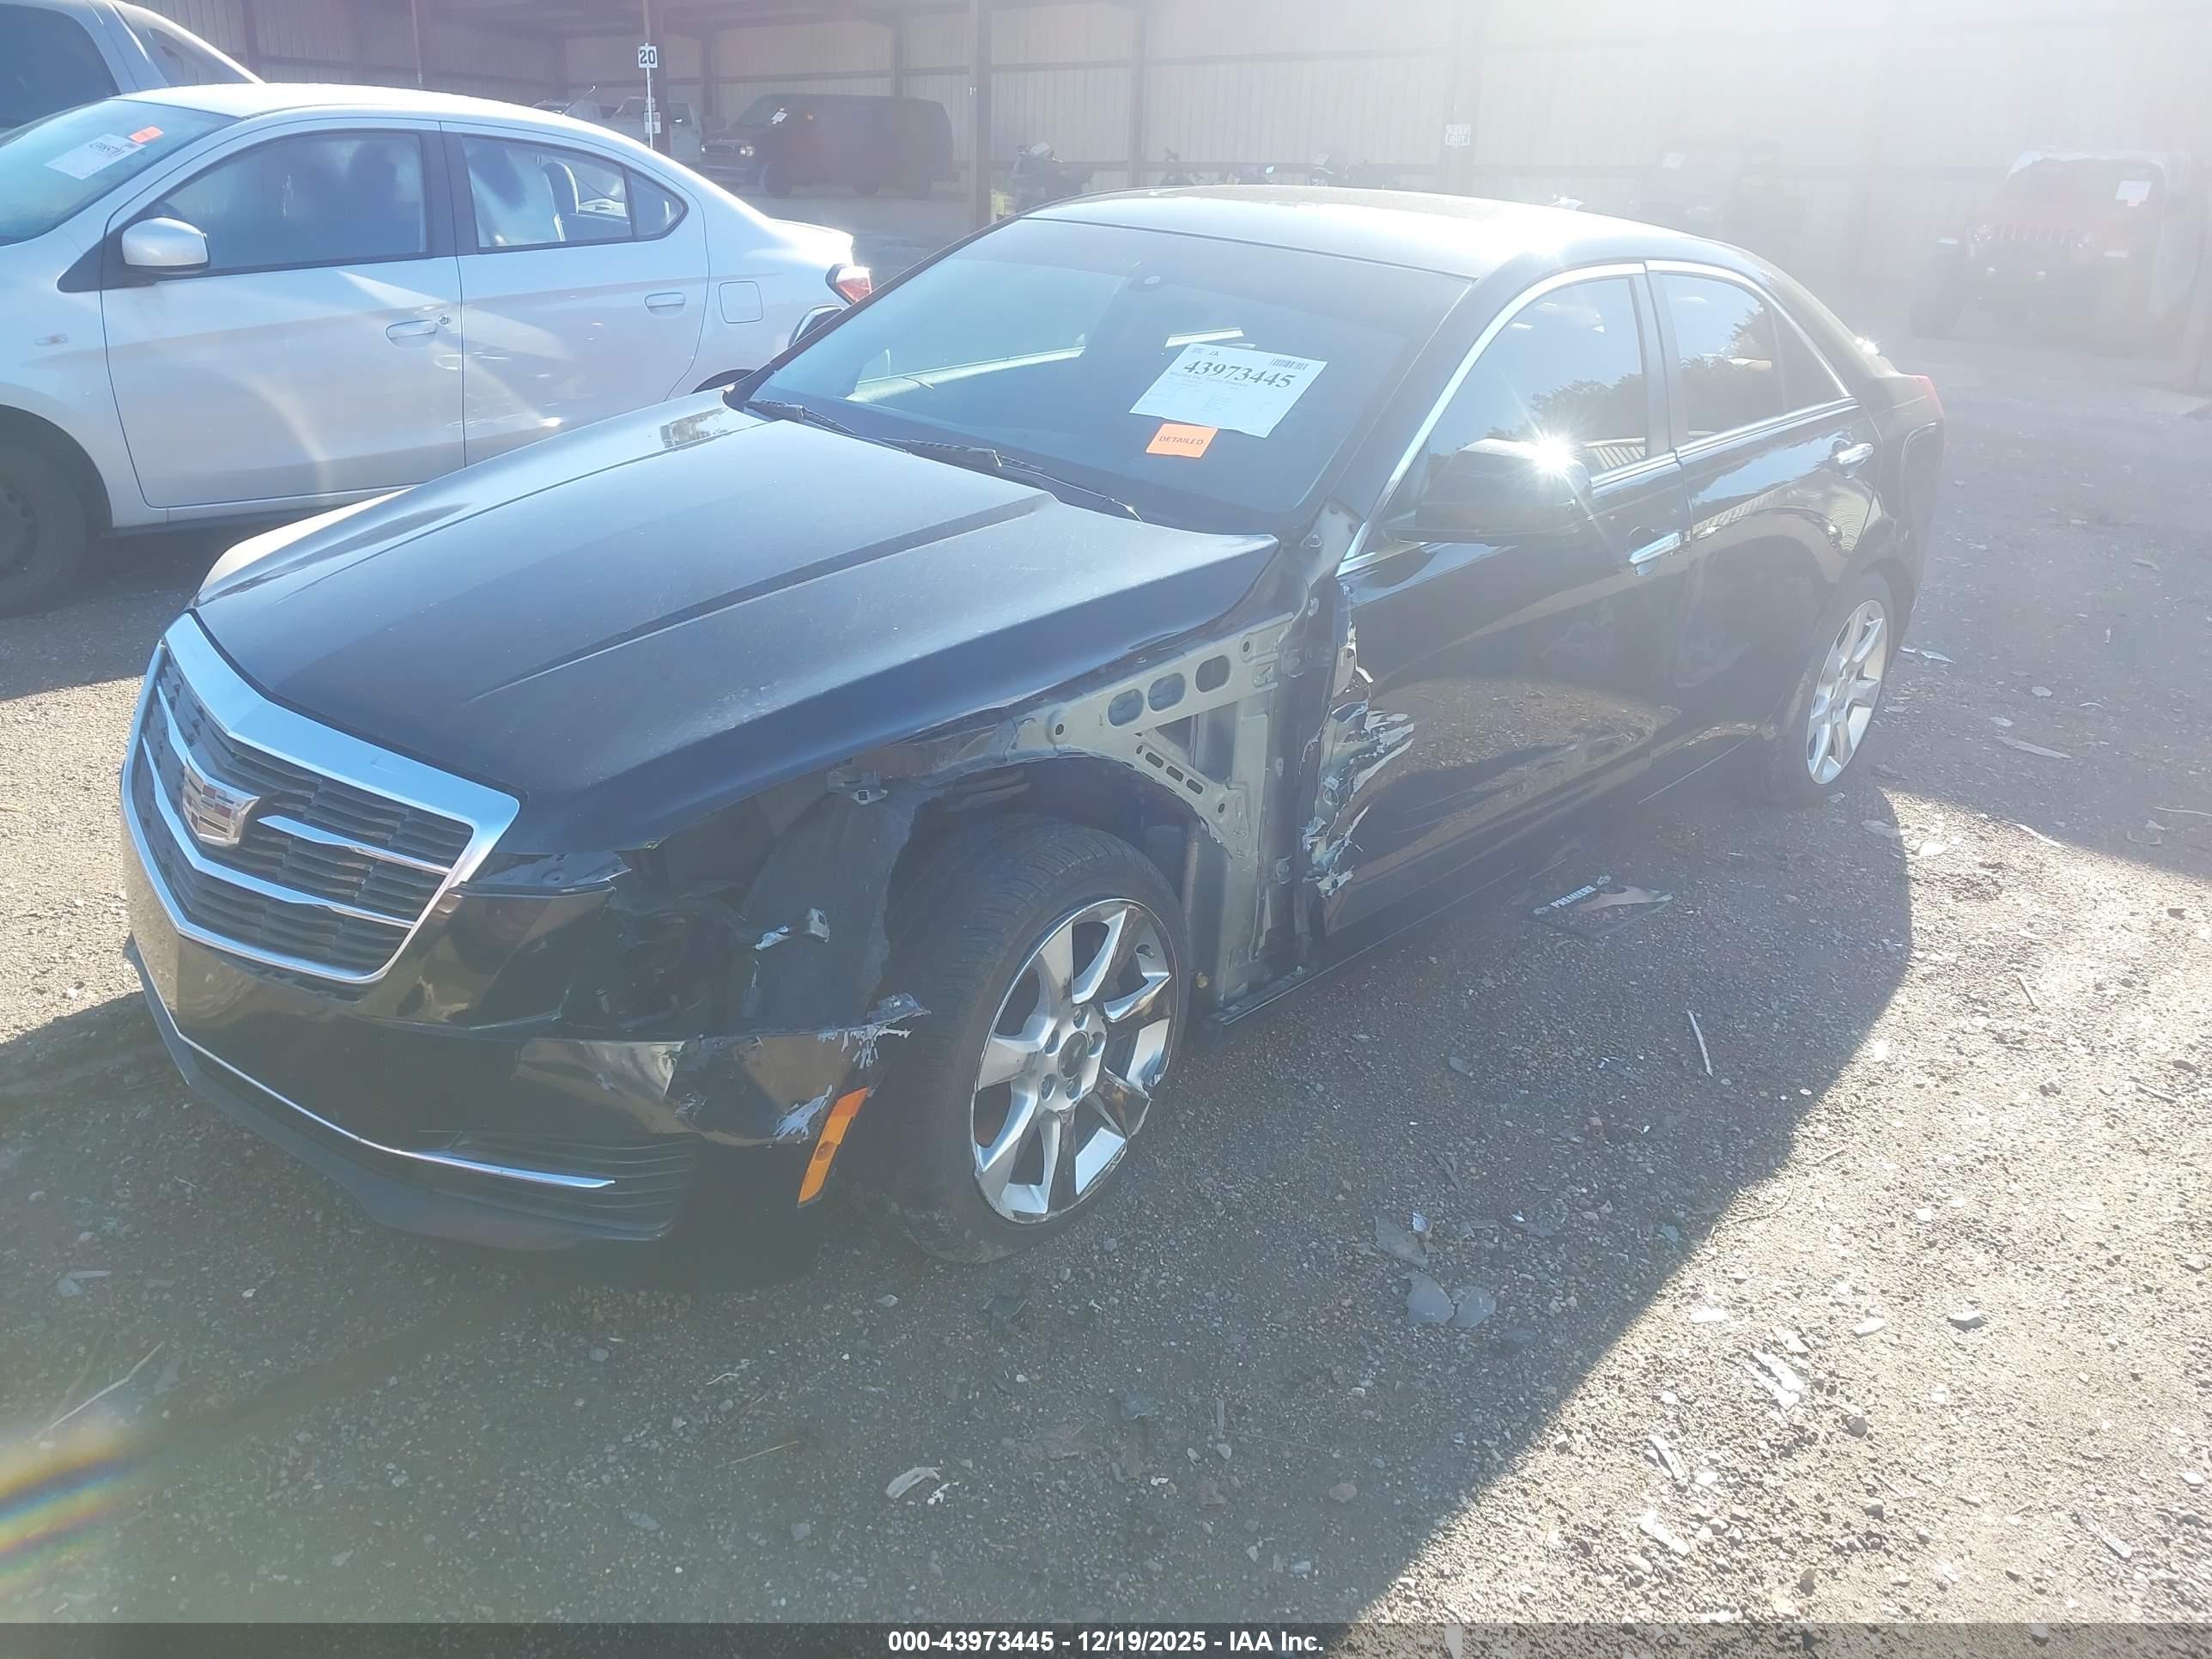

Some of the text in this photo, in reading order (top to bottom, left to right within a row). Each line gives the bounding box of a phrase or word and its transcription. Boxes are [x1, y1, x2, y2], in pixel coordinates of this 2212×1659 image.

[640, 50, 656, 64] 20
[1183, 360, 1296, 388] 43973445
[1158, 435, 1204, 446] DETAILED
[1549, 885, 1597, 908] PREMIERE
